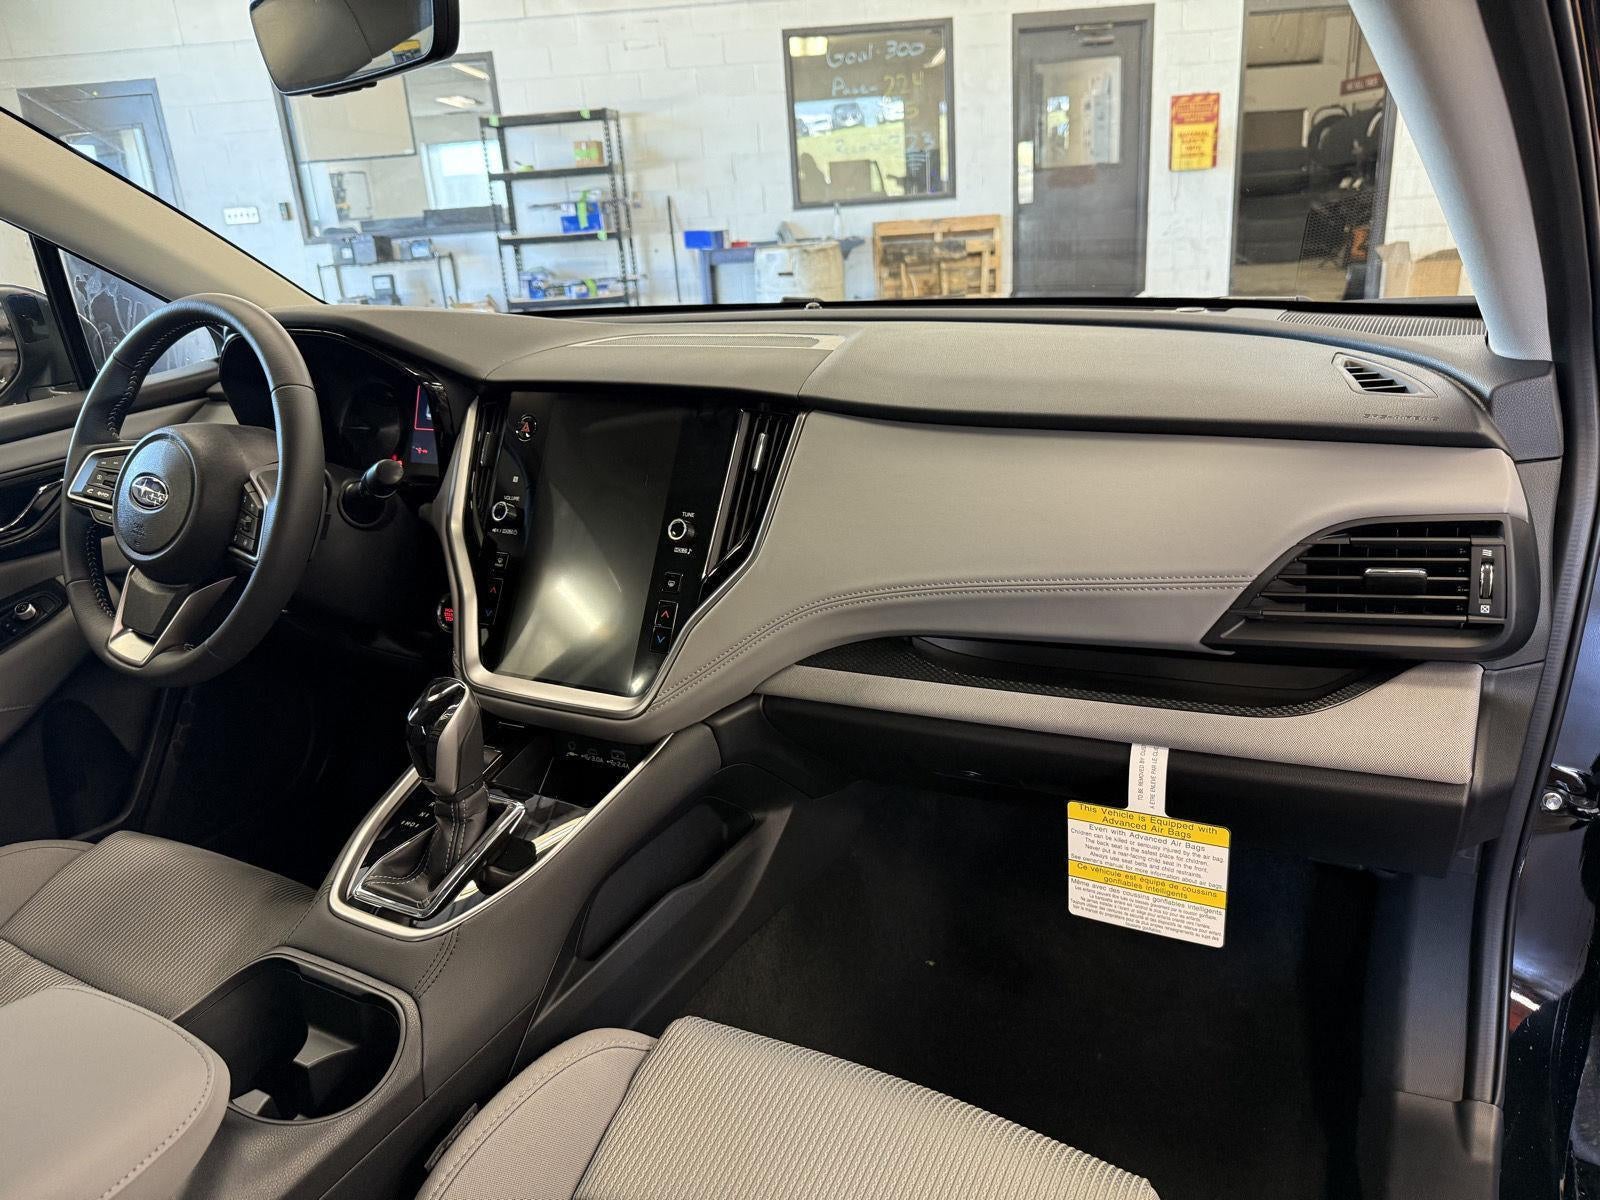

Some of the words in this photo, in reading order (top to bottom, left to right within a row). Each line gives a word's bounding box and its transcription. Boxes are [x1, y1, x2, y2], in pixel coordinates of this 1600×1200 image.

[885, 40, 925, 60] 300
[1080, 804, 1097, 813] This
[1101, 808, 1134, 820] Vehicle
[1150, 817, 1194, 832] Equipped
[1198, 825, 1217, 835] with
[1102, 816, 1146, 831] Advanced
[1151, 825, 1163, 834] Air
[1168, 828, 1192, 840] Bags
[1089, 824, 1107, 833] Even
[1111, 828, 1125, 836] with
[1129, 832, 1167, 845] Advanced
[1185, 842, 1205, 853] Bags
[1090, 851, 1108, 860] Always
[1160, 853, 1174, 861] place
[1091, 866, 1121, 878] véhicule
[1182, 886, 1217, 897] coussins
[1104, 876, 1142, 890] gonflables
[1146, 885, 1188, 900] intelligents
[1123, 890, 1149, 900] coussins
[1153, 897, 1185, 909] gonflables
